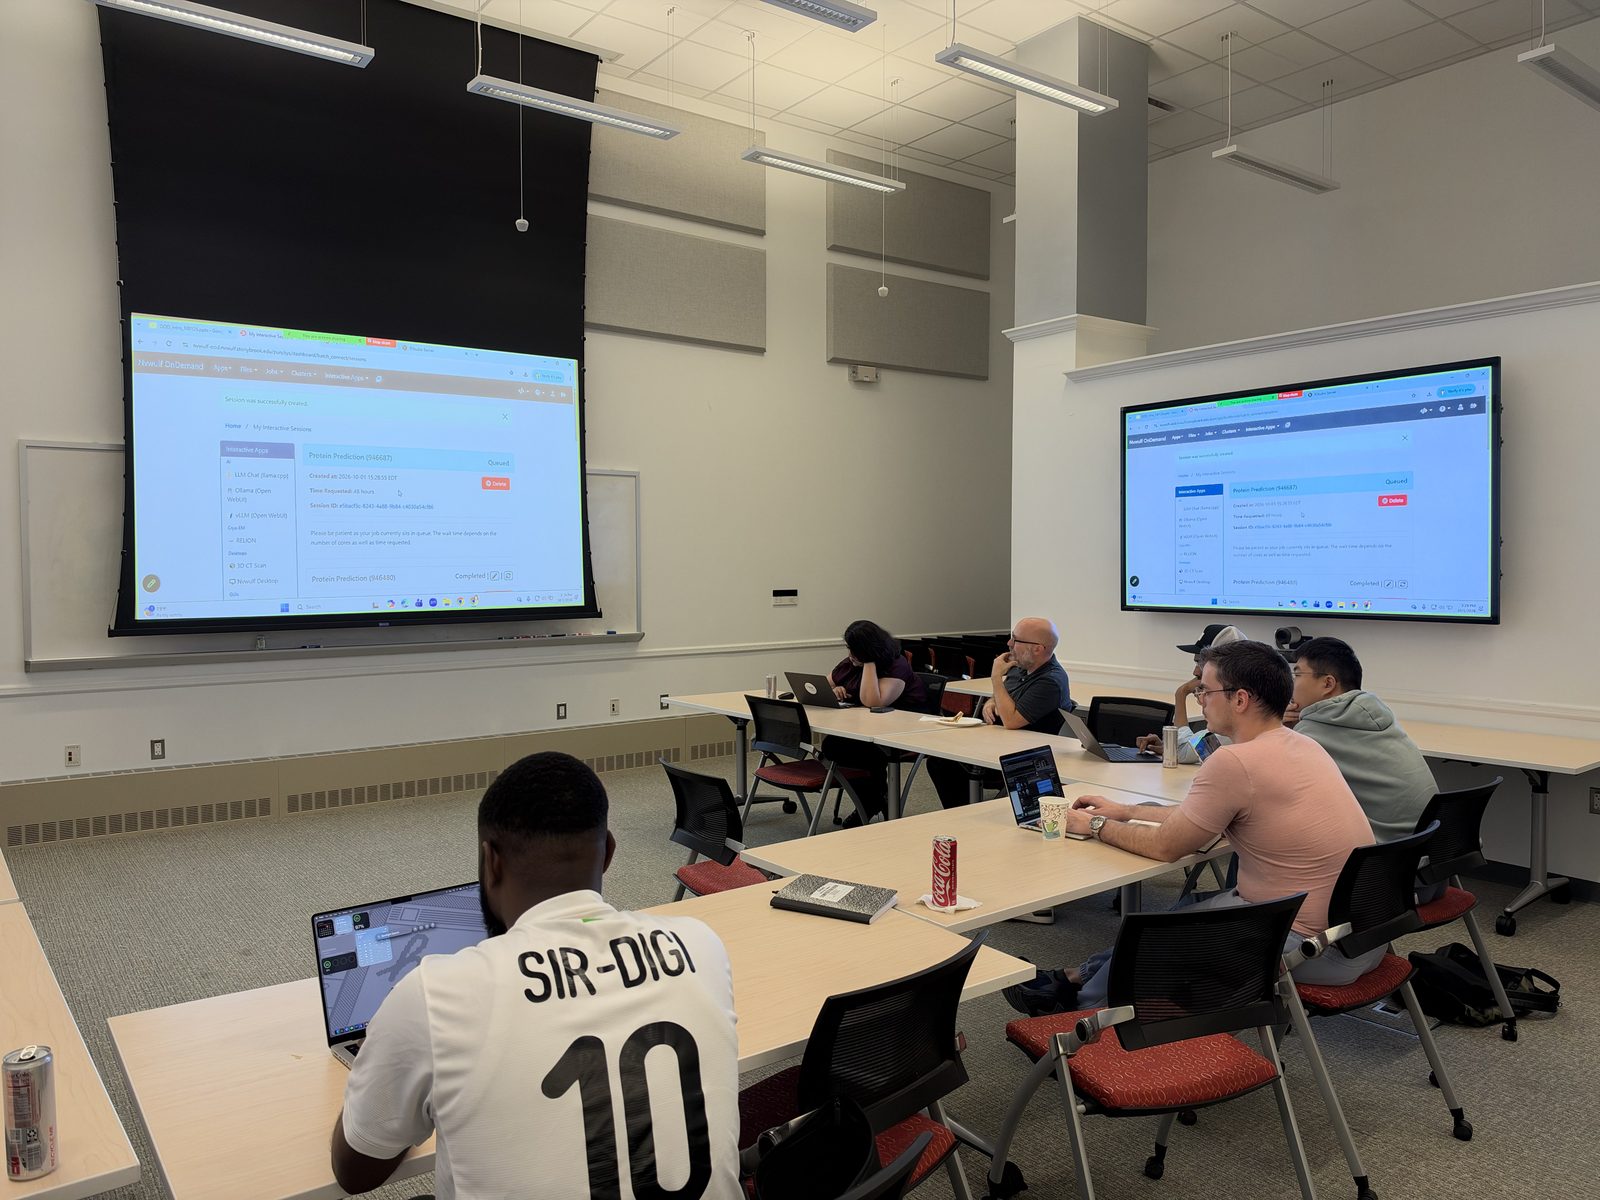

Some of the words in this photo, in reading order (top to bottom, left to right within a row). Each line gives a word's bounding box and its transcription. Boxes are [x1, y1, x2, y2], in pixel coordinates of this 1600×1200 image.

[164, 361, 204, 370] OnDemand
[213, 364, 228, 372] Apps
[257, 398, 287, 407] successfully
[1144, 436, 1166, 444] OnDemand
[308, 452, 332, 460] Protein
[333, 453, 364, 461] Prediction
[488, 459, 510, 467] Queued
[1385, 478, 1408, 486] Queued
[518, 929, 696, 1003] SIR-DIGI
[541, 1021, 712, 1200] 10
